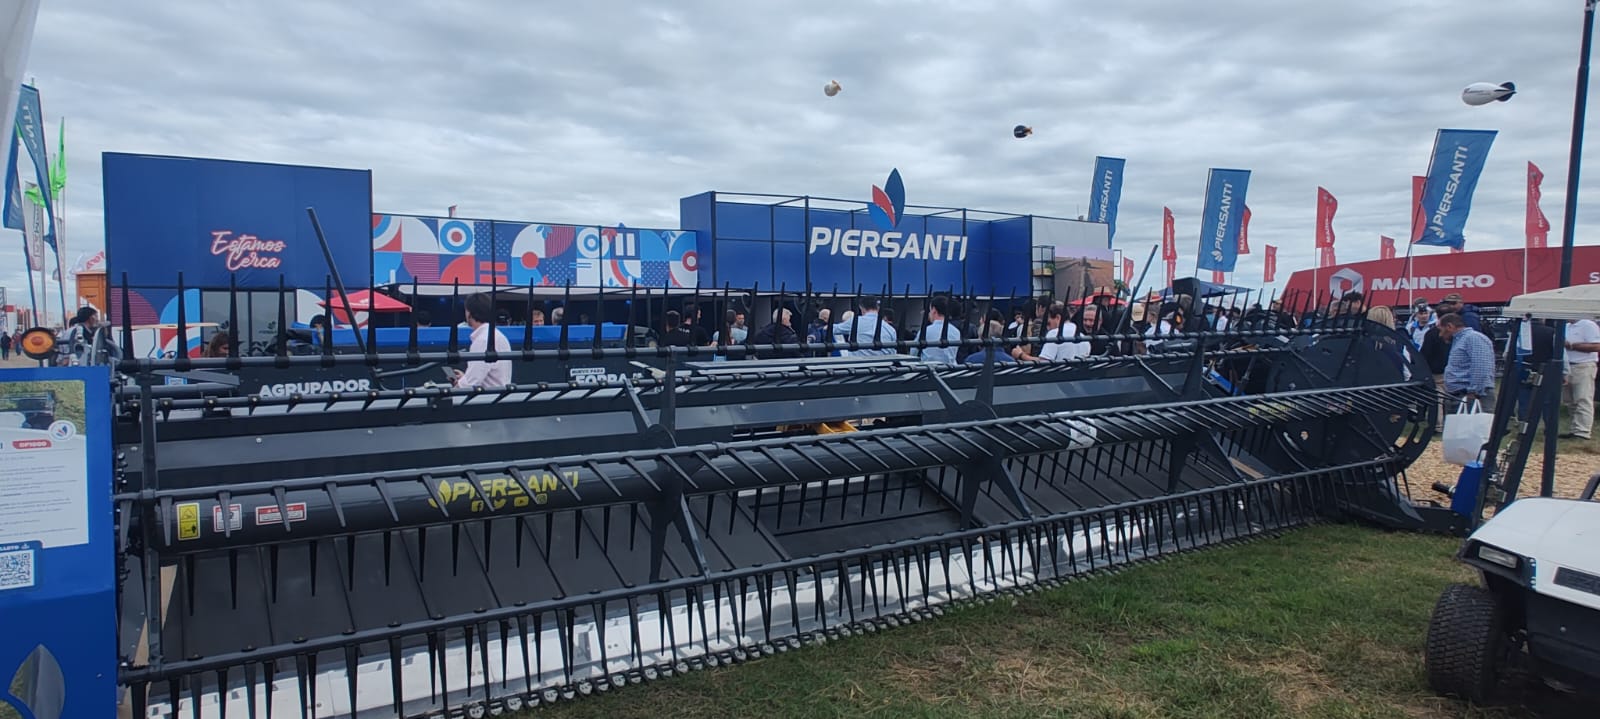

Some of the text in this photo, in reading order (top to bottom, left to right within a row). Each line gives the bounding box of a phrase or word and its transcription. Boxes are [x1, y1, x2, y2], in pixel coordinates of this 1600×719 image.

[1098, 169, 1113, 223] IERSANTI
[1432, 146, 1468, 226] PIERSANTI
[1214, 183, 1233, 250] PIERSANTI
[211, 230, 287, 257] Estamos
[809, 226, 968, 261] PIERSANTI
[227, 250, 281, 271] Cerca
[1371, 274, 1495, 291] MAINERO
[259, 379, 370, 398] AGRUPADOR
